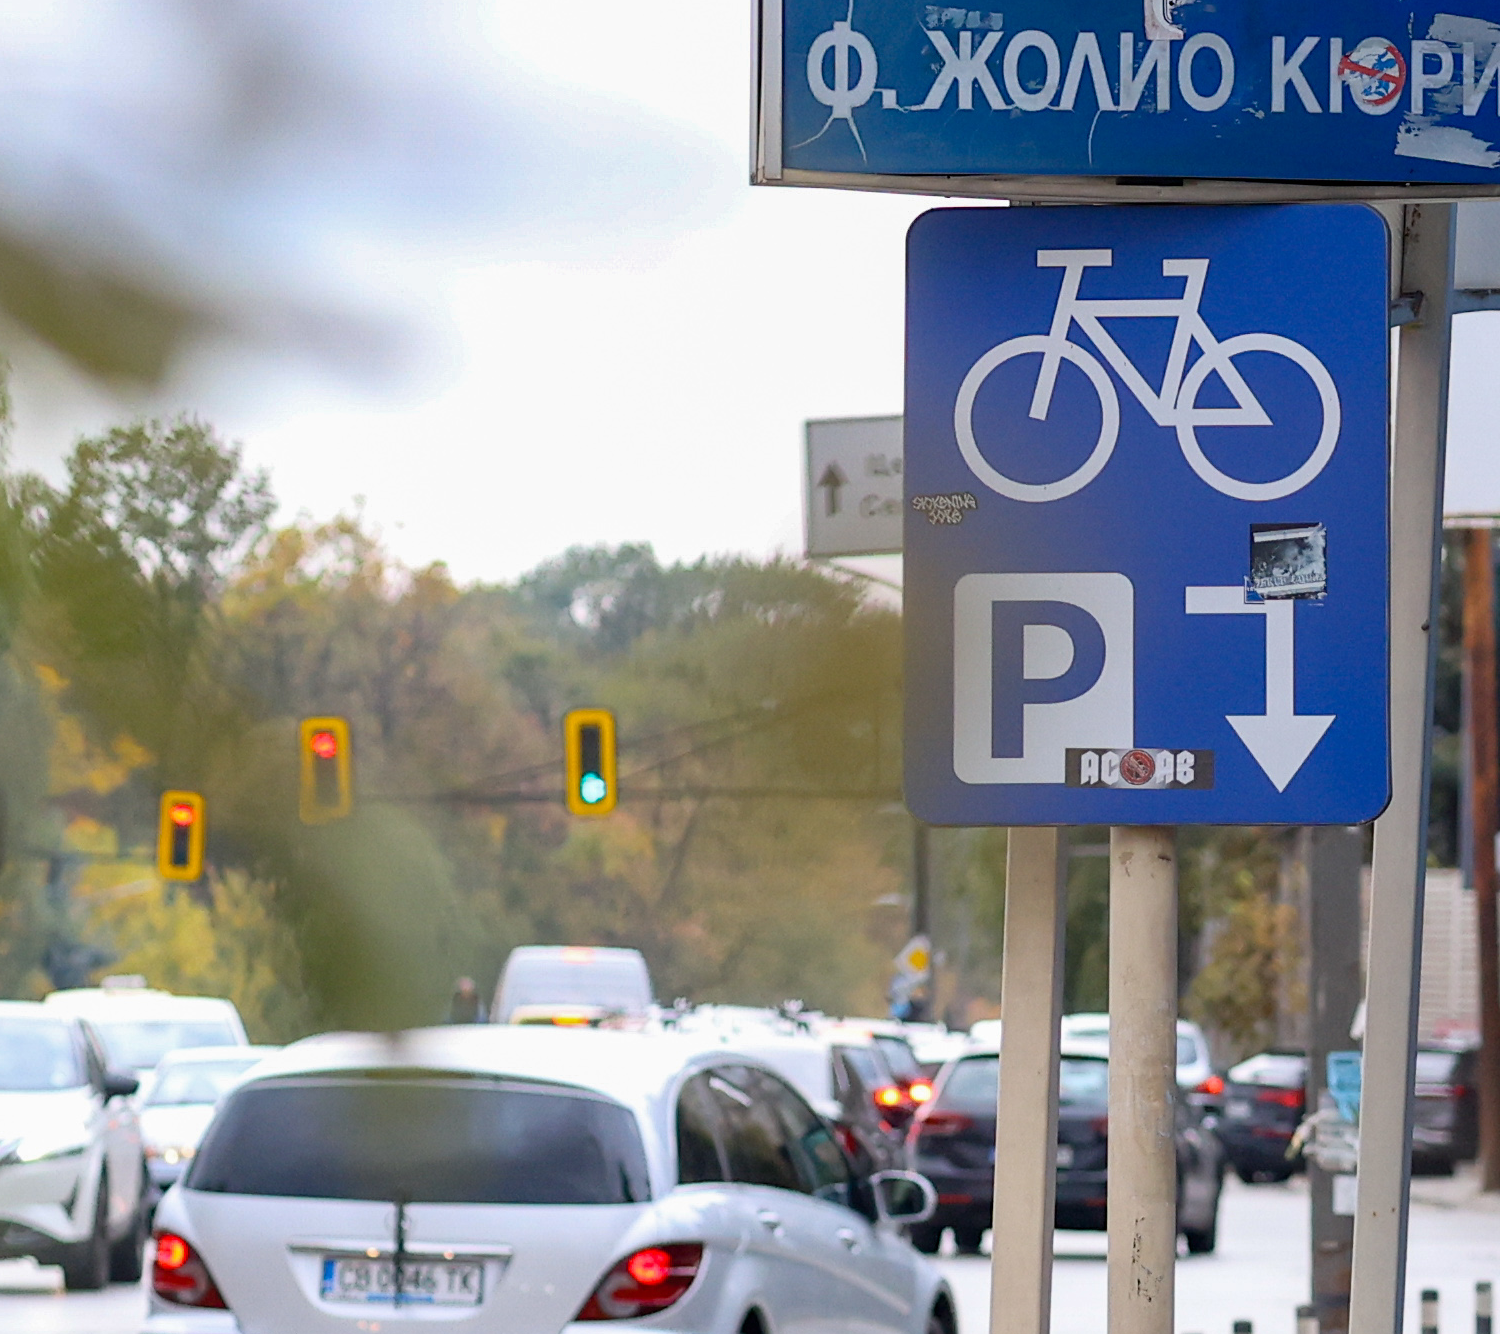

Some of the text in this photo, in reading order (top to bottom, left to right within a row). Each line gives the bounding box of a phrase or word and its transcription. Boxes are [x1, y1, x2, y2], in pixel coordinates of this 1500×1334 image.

[807, 21, 897, 119] Ф.
[920, 29, 1236, 113] ЖОЛИО
[990, 600, 1107, 759] P
